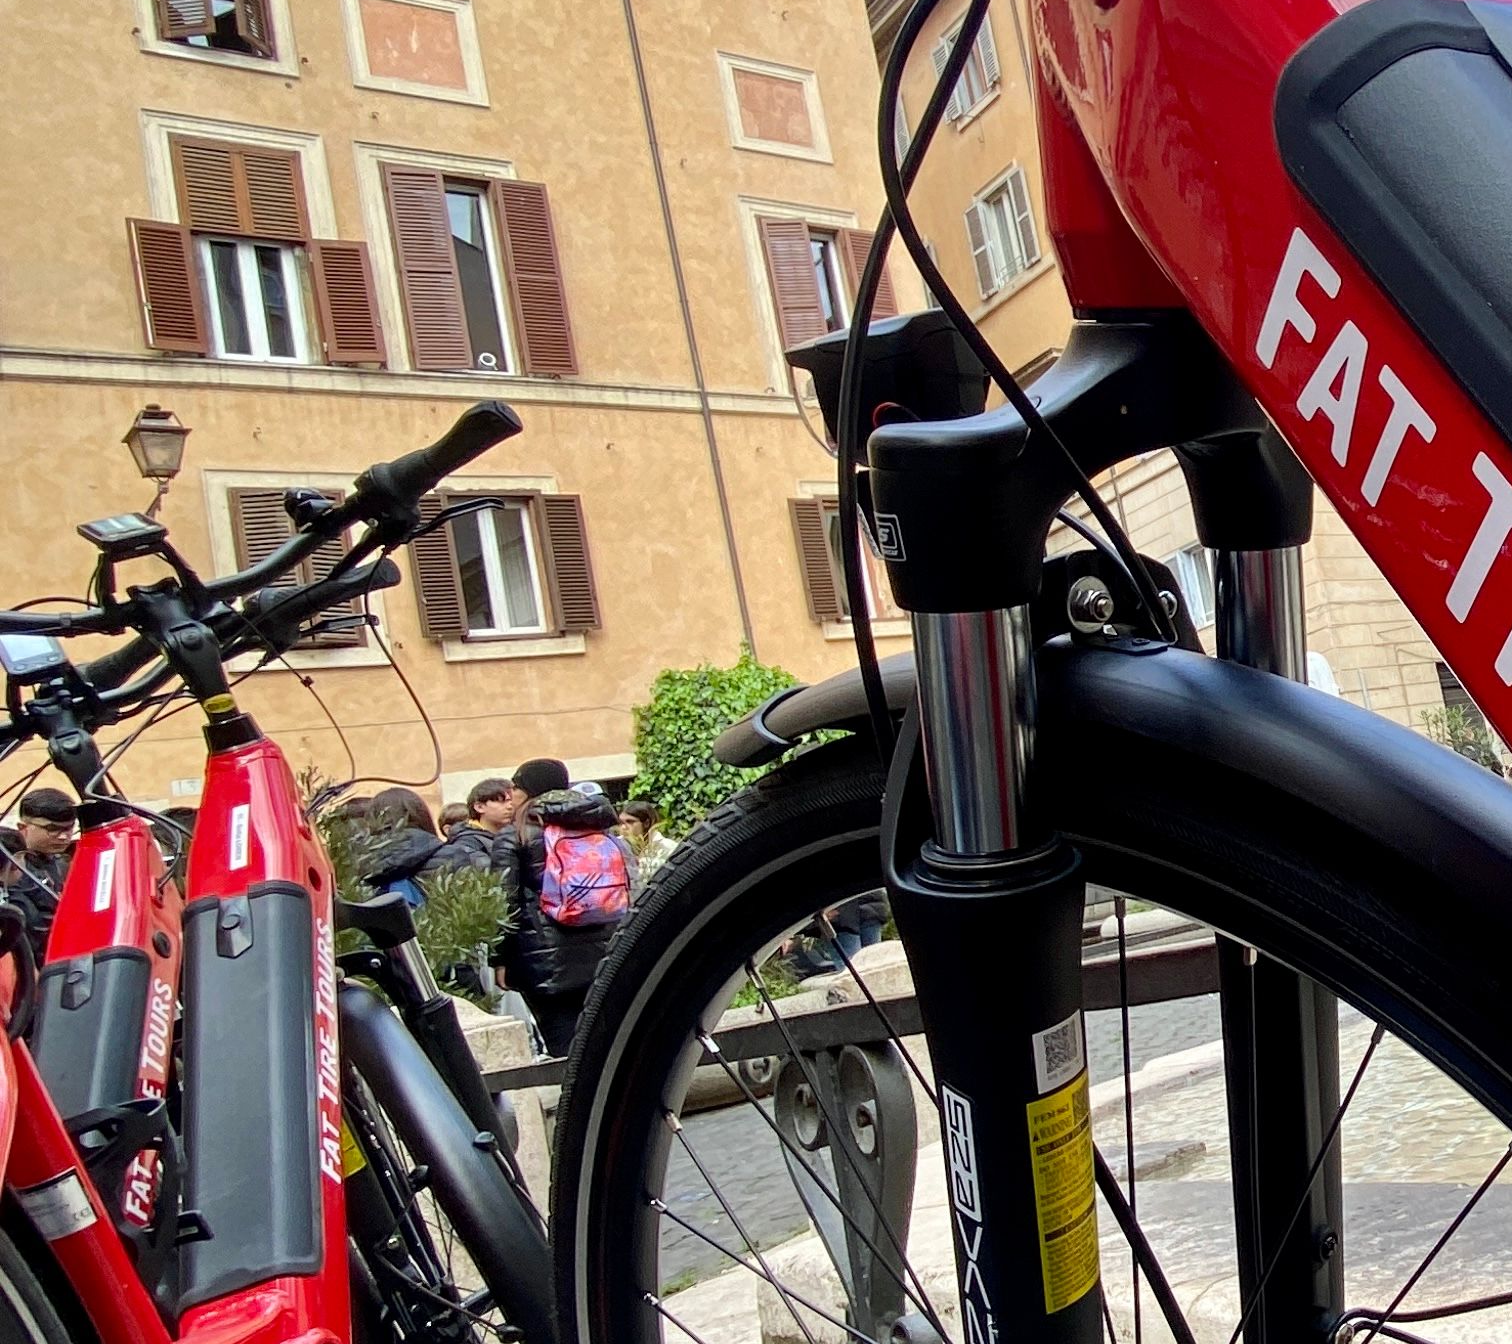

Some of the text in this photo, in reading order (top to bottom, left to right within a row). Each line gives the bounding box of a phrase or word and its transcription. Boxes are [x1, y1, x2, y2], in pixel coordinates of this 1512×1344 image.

[1255, 227, 1437, 507] FAT
[125, 1156, 155, 1222] FAT
[141, 978, 173, 1073] TOURS
[316, 918, 342, 1185] FAT TIRE TOURS
